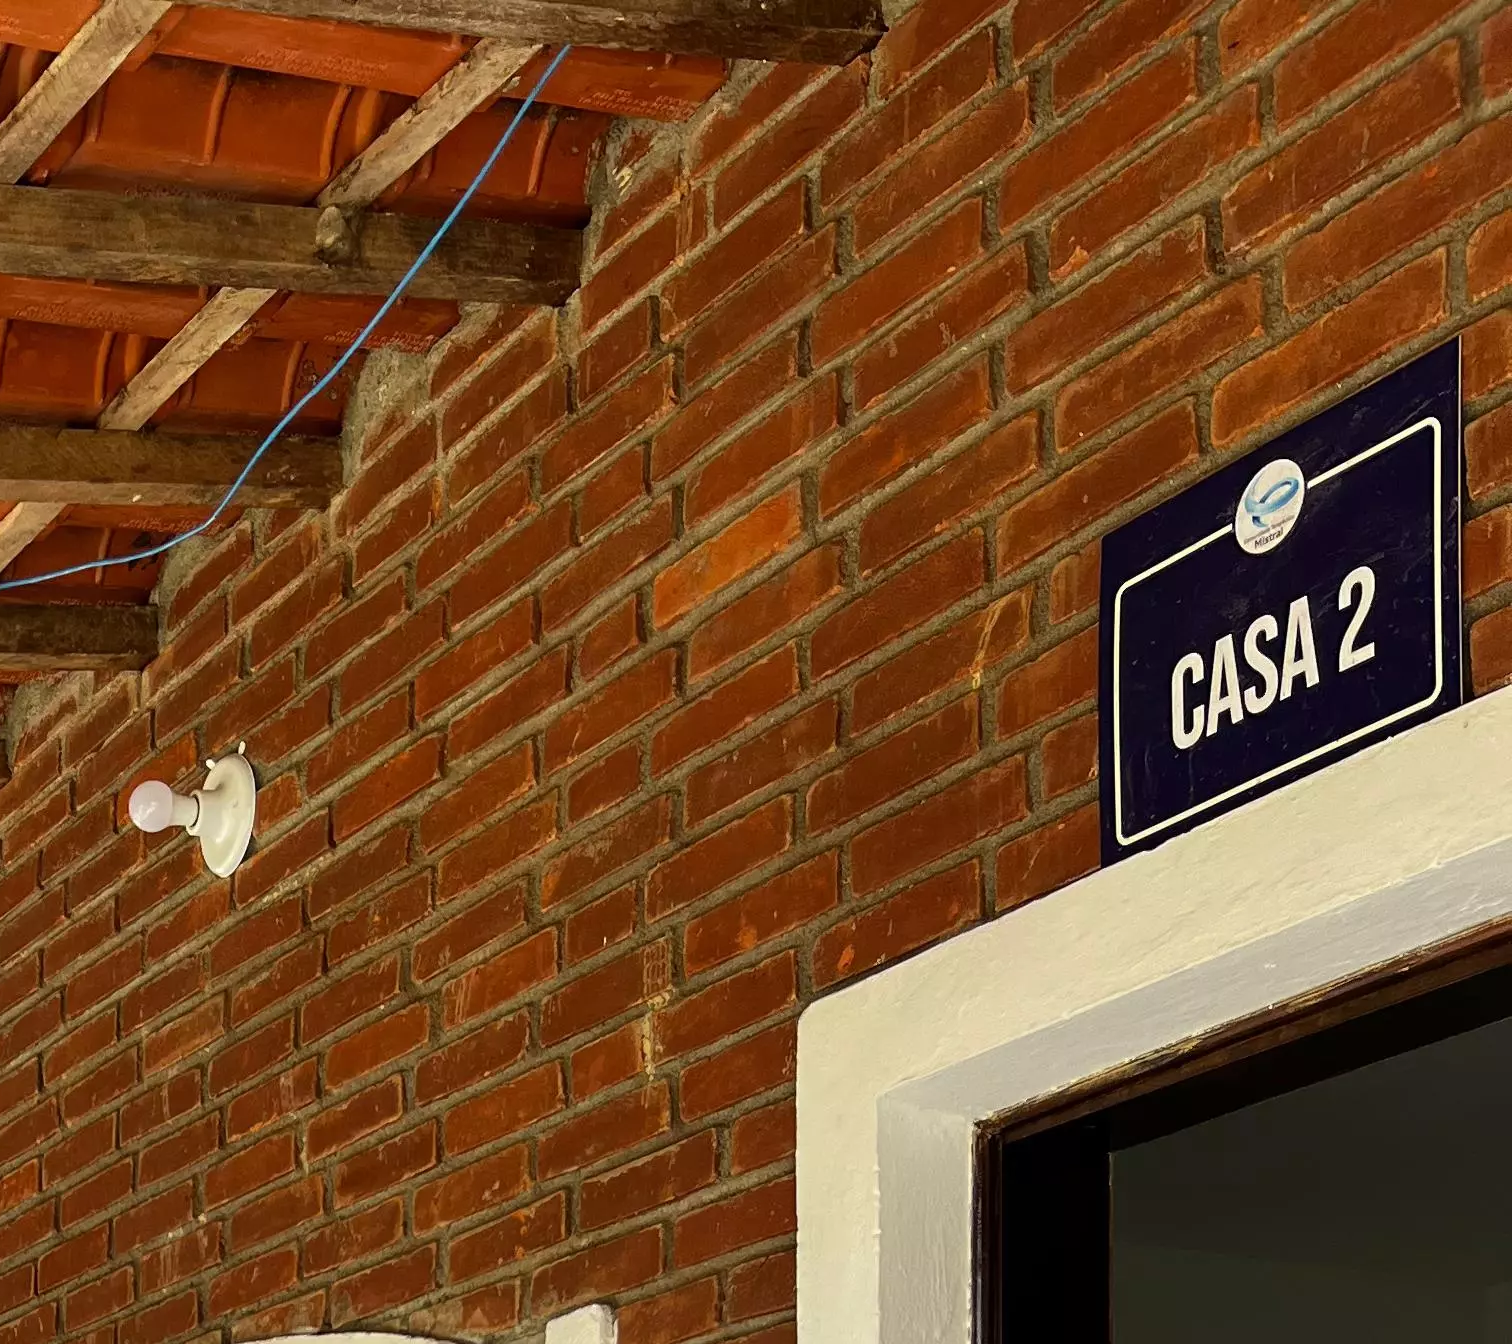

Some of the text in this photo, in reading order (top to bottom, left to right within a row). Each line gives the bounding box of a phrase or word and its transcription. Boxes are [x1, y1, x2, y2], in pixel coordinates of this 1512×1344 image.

[1254, 527, 1284, 550] Mistral
[1172, 566, 1376, 750] CASA 2
